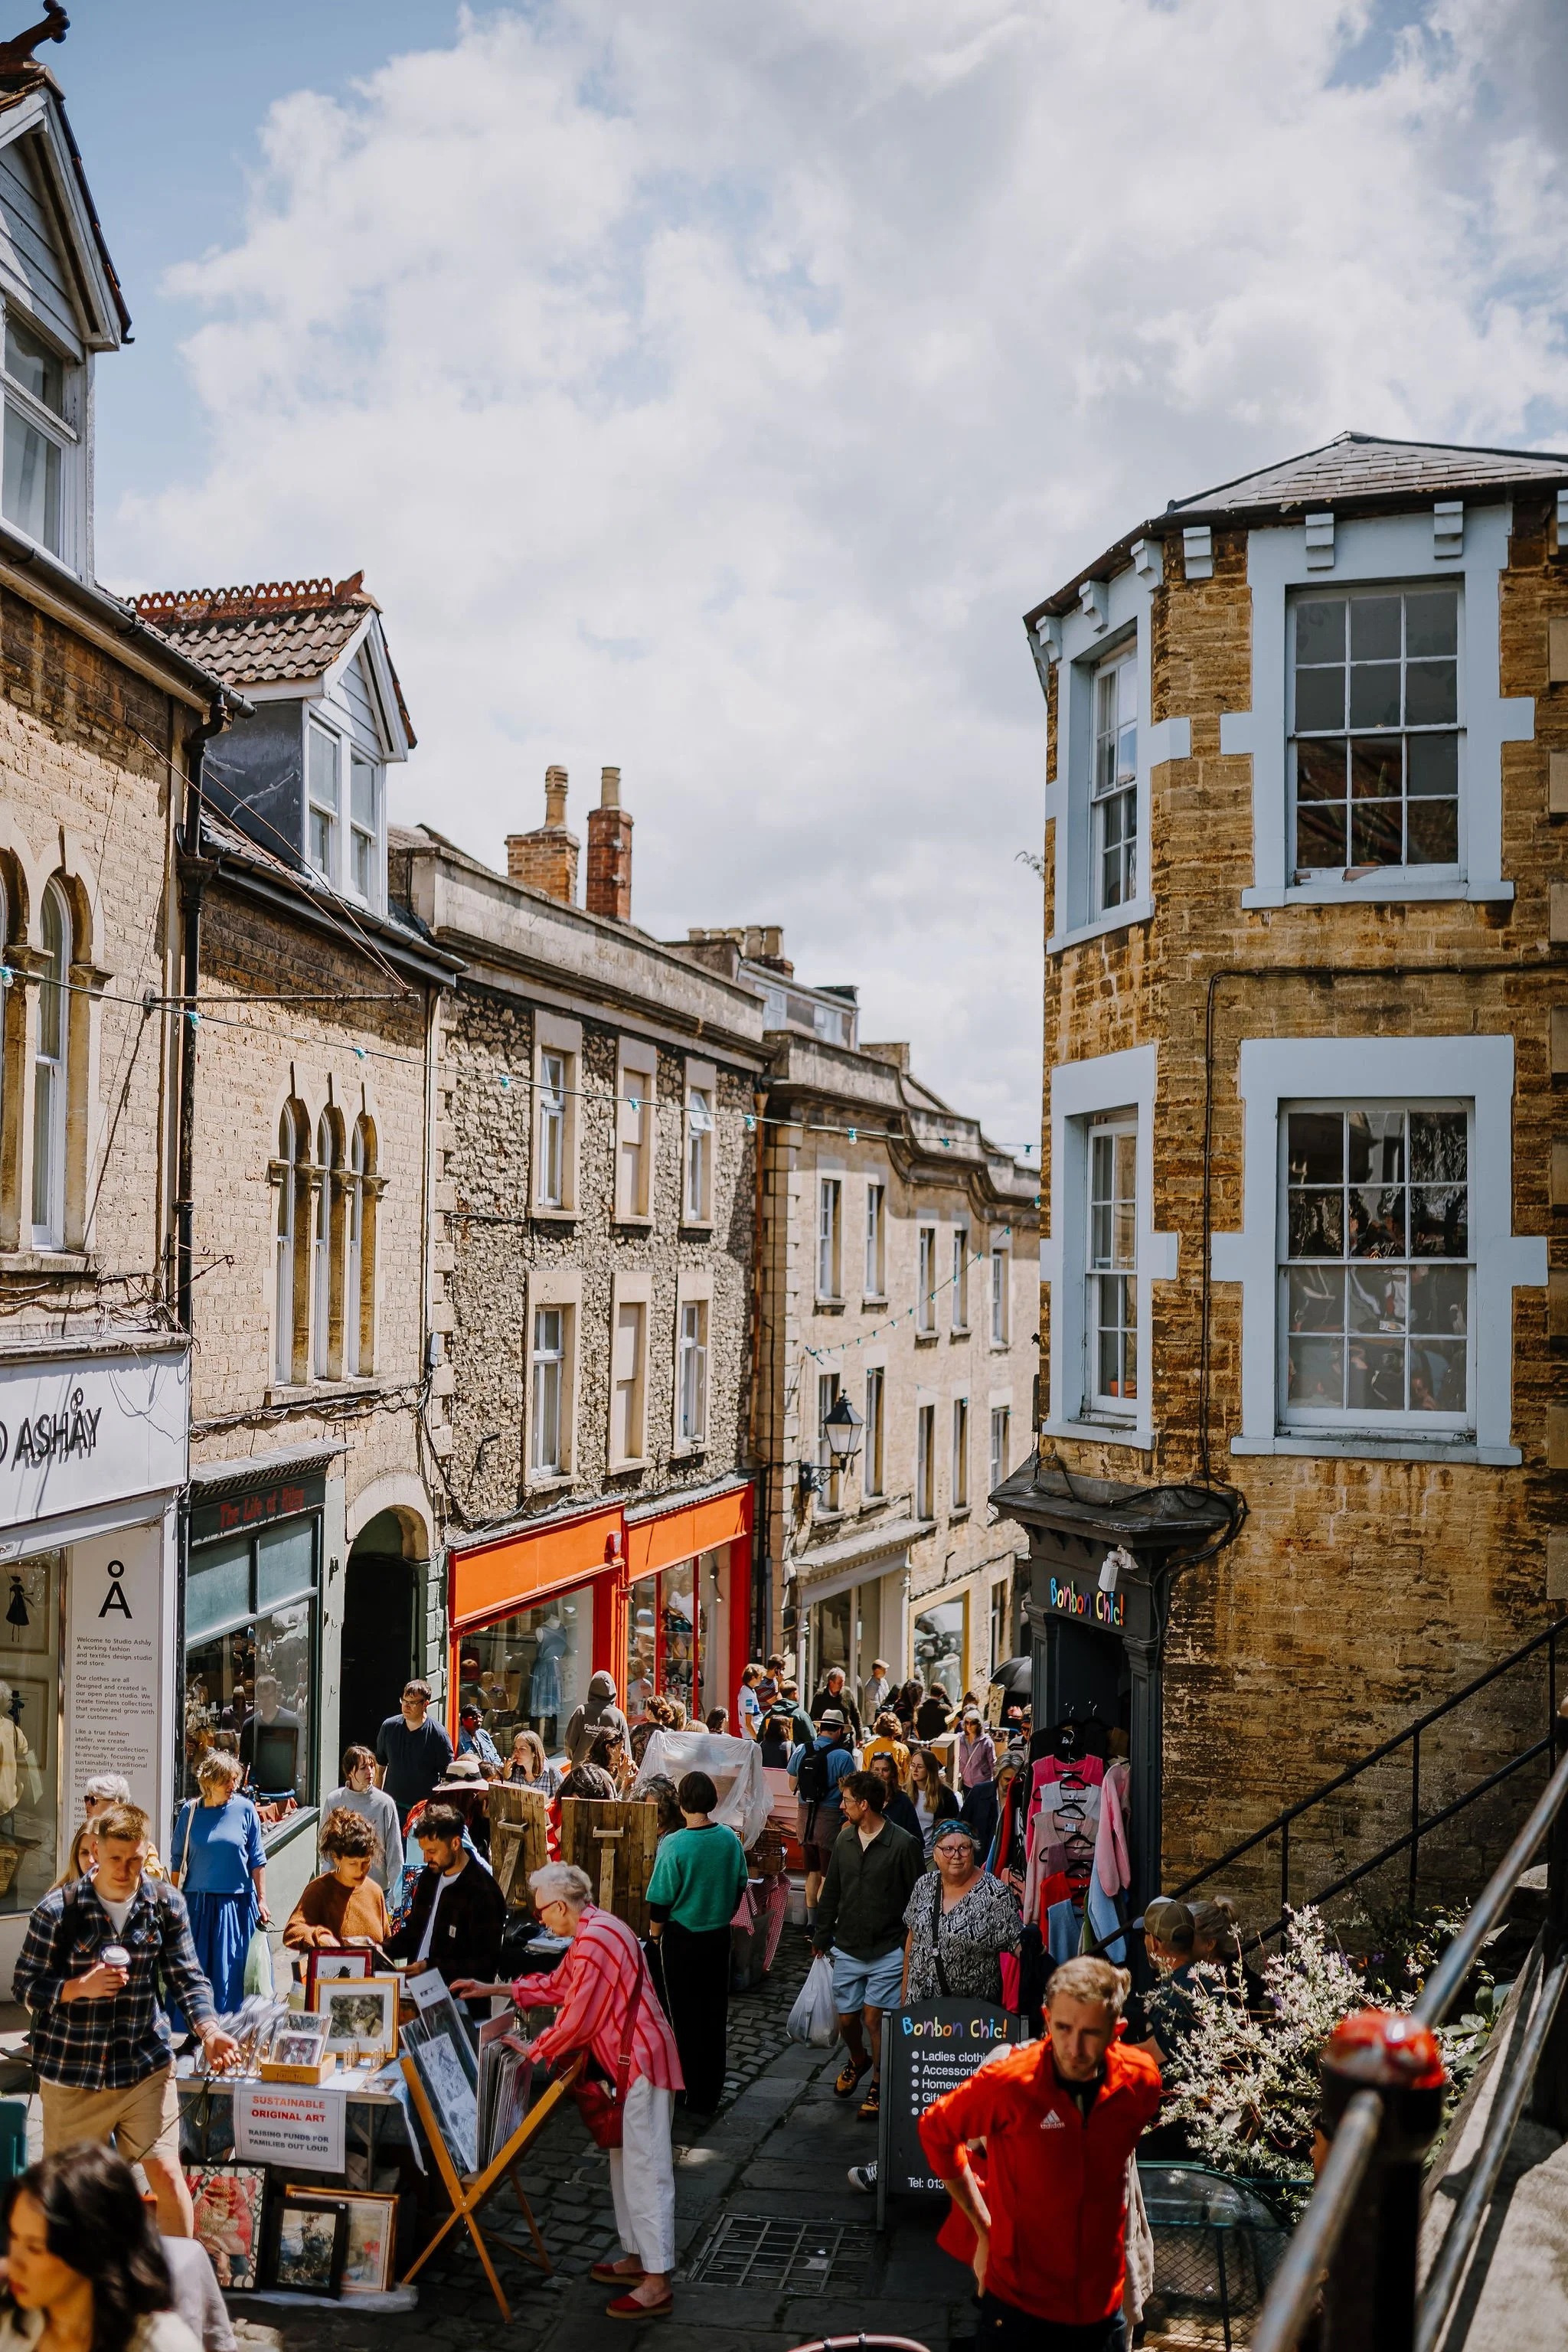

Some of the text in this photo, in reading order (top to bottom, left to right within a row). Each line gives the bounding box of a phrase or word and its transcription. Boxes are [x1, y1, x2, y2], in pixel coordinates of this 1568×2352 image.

[15, 1387, 102, 1462] ASHÅY
[220, 1503, 240, 1528] The
[243, 1495, 263, 1521] Life
[266, 1491, 277, 1514] of
[98, 1560, 132, 1619] Å
[1050, 1577, 1123, 1626] Bonbon Chic!
[902, 2017, 1008, 2038] Bonbon Chic!
[922, 2050, 988, 2063] Ladies clothi
[923, 2064, 978, 2076] Accessorie
[253, 2096, 325, 2109] SUSTAINABLE
[922, 2092, 941, 2103] Gift
[251, 2109, 302, 2121] ORIGINAL
[248, 2129, 281, 2138] RAISING
[283, 2133, 310, 2141] FUNDS
[250, 2138, 286, 2148] FAMILIES
[907, 2177, 924, 2188] Tel:
